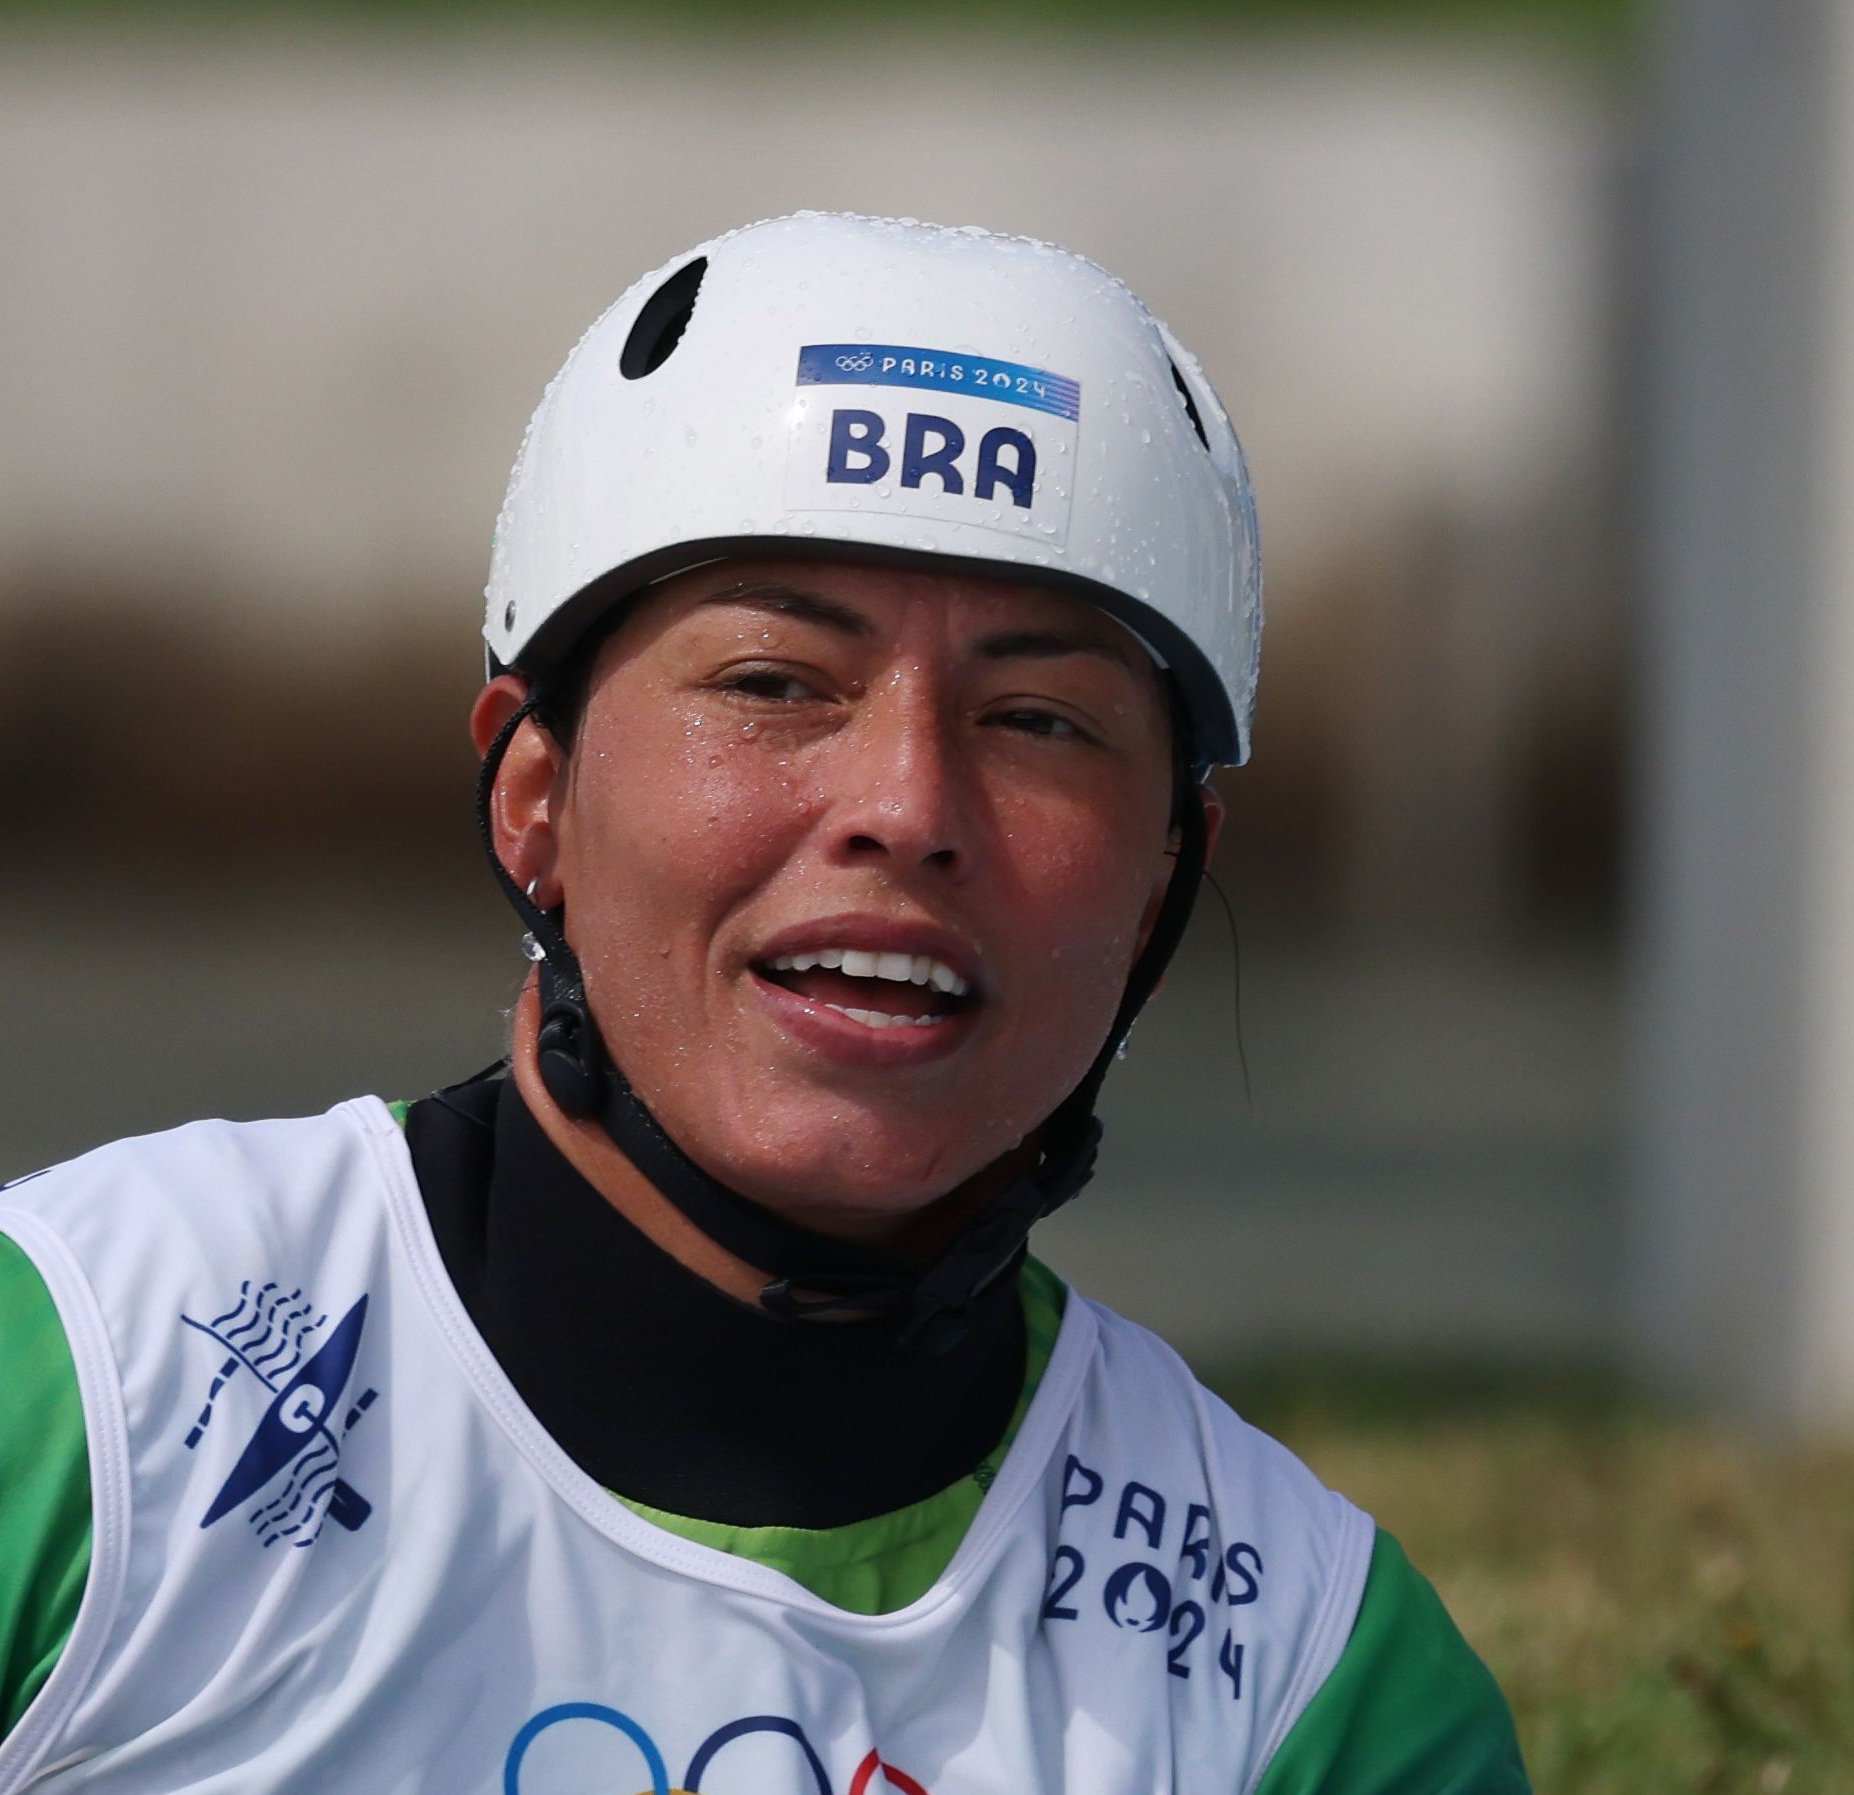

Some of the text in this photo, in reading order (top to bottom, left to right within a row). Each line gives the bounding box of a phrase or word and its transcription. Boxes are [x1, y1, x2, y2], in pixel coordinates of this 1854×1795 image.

[974, 368, 1046, 399] 2024
[826, 409, 1038, 510] BRA
[1044, 1545, 1245, 1700] 2024
